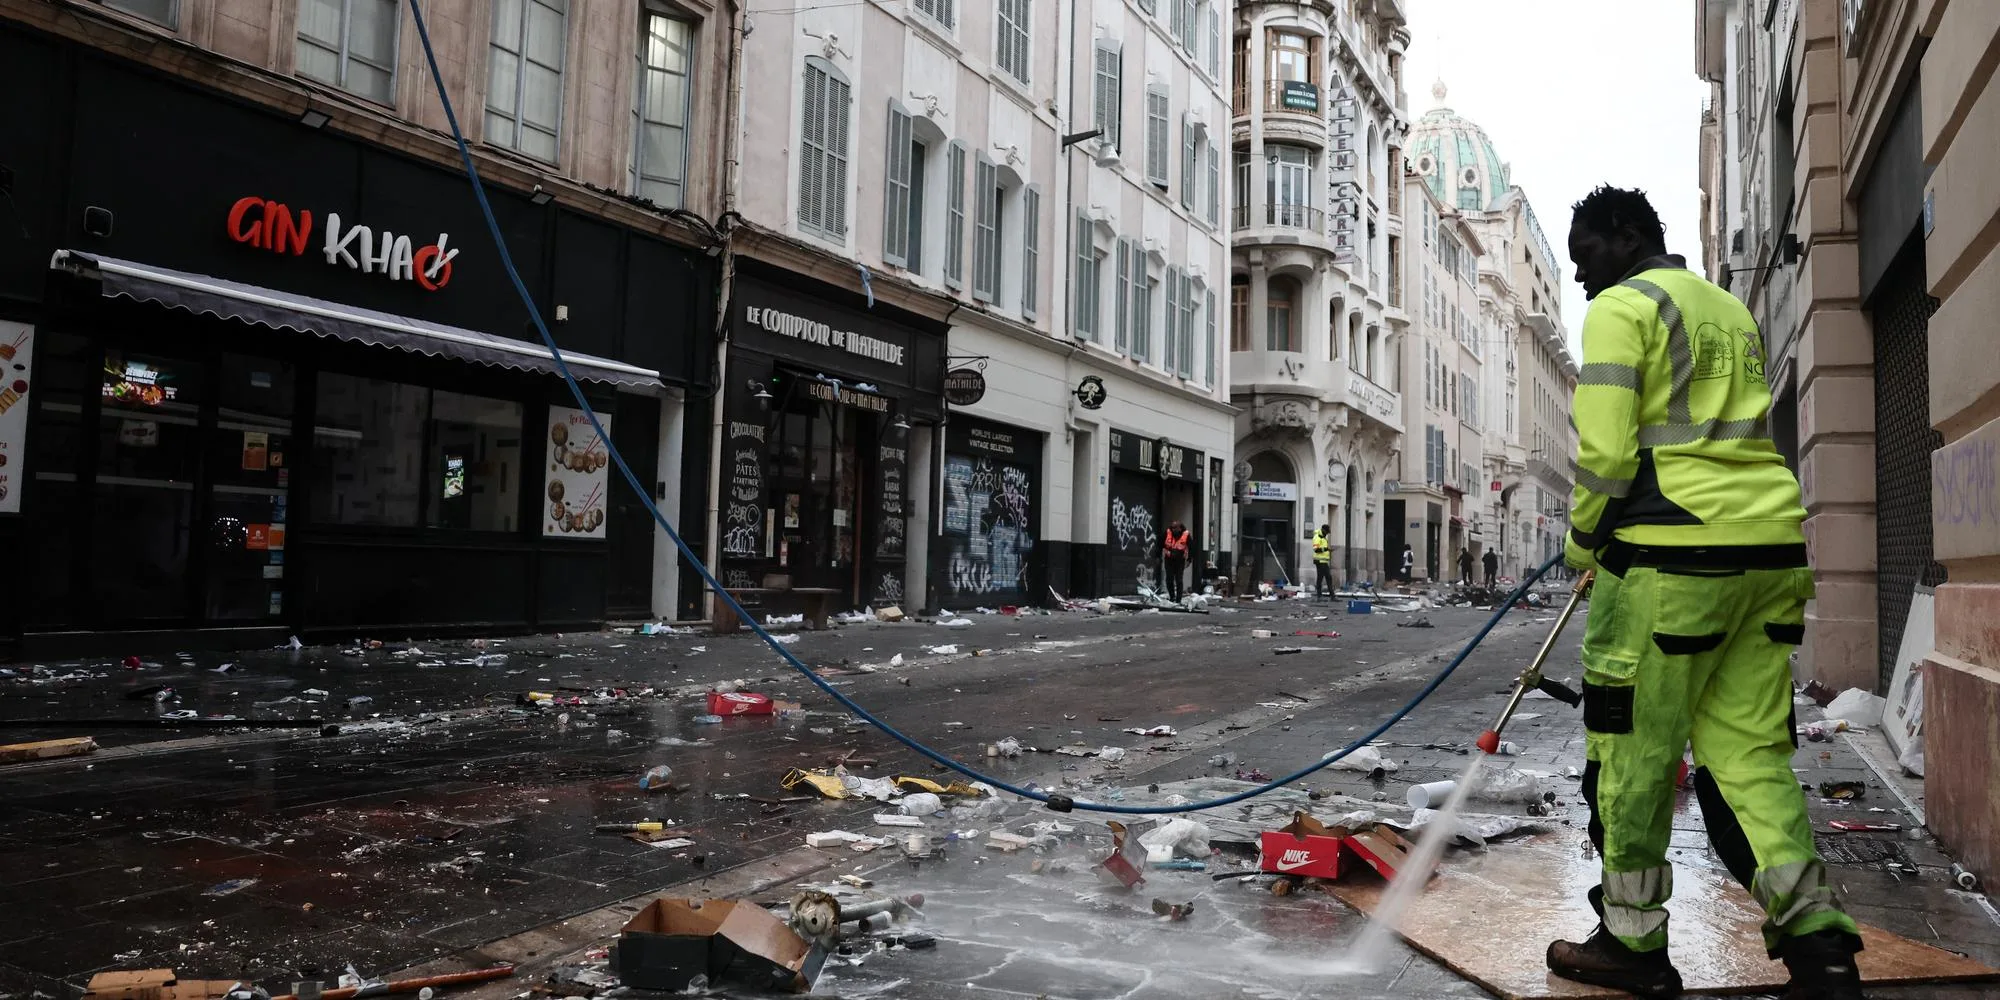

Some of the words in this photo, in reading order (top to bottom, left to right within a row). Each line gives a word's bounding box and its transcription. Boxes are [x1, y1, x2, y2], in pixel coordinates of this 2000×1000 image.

[1336, 87, 1348, 167] ALLEN
[227, 197, 312, 256] GIN
[323, 212, 459, 291] KHAO
[1336, 187, 1348, 246] CARR
[747, 306, 760, 324] LE
[762, 308, 830, 346] COMPTOIR
[832, 330, 845, 347] DE
[846, 332, 904, 366] MATHILDE
[810, 384, 816, 395] LE
[816, 384, 850, 404] COMOIR
[850, 392, 857, 404] DE
[857, 392, 888, 412] MATHILDE
[969, 439, 989, 449] VINTAGE
[990, 443, 1014, 454] SELECTION
[1283, 849, 1311, 863] NIKE
